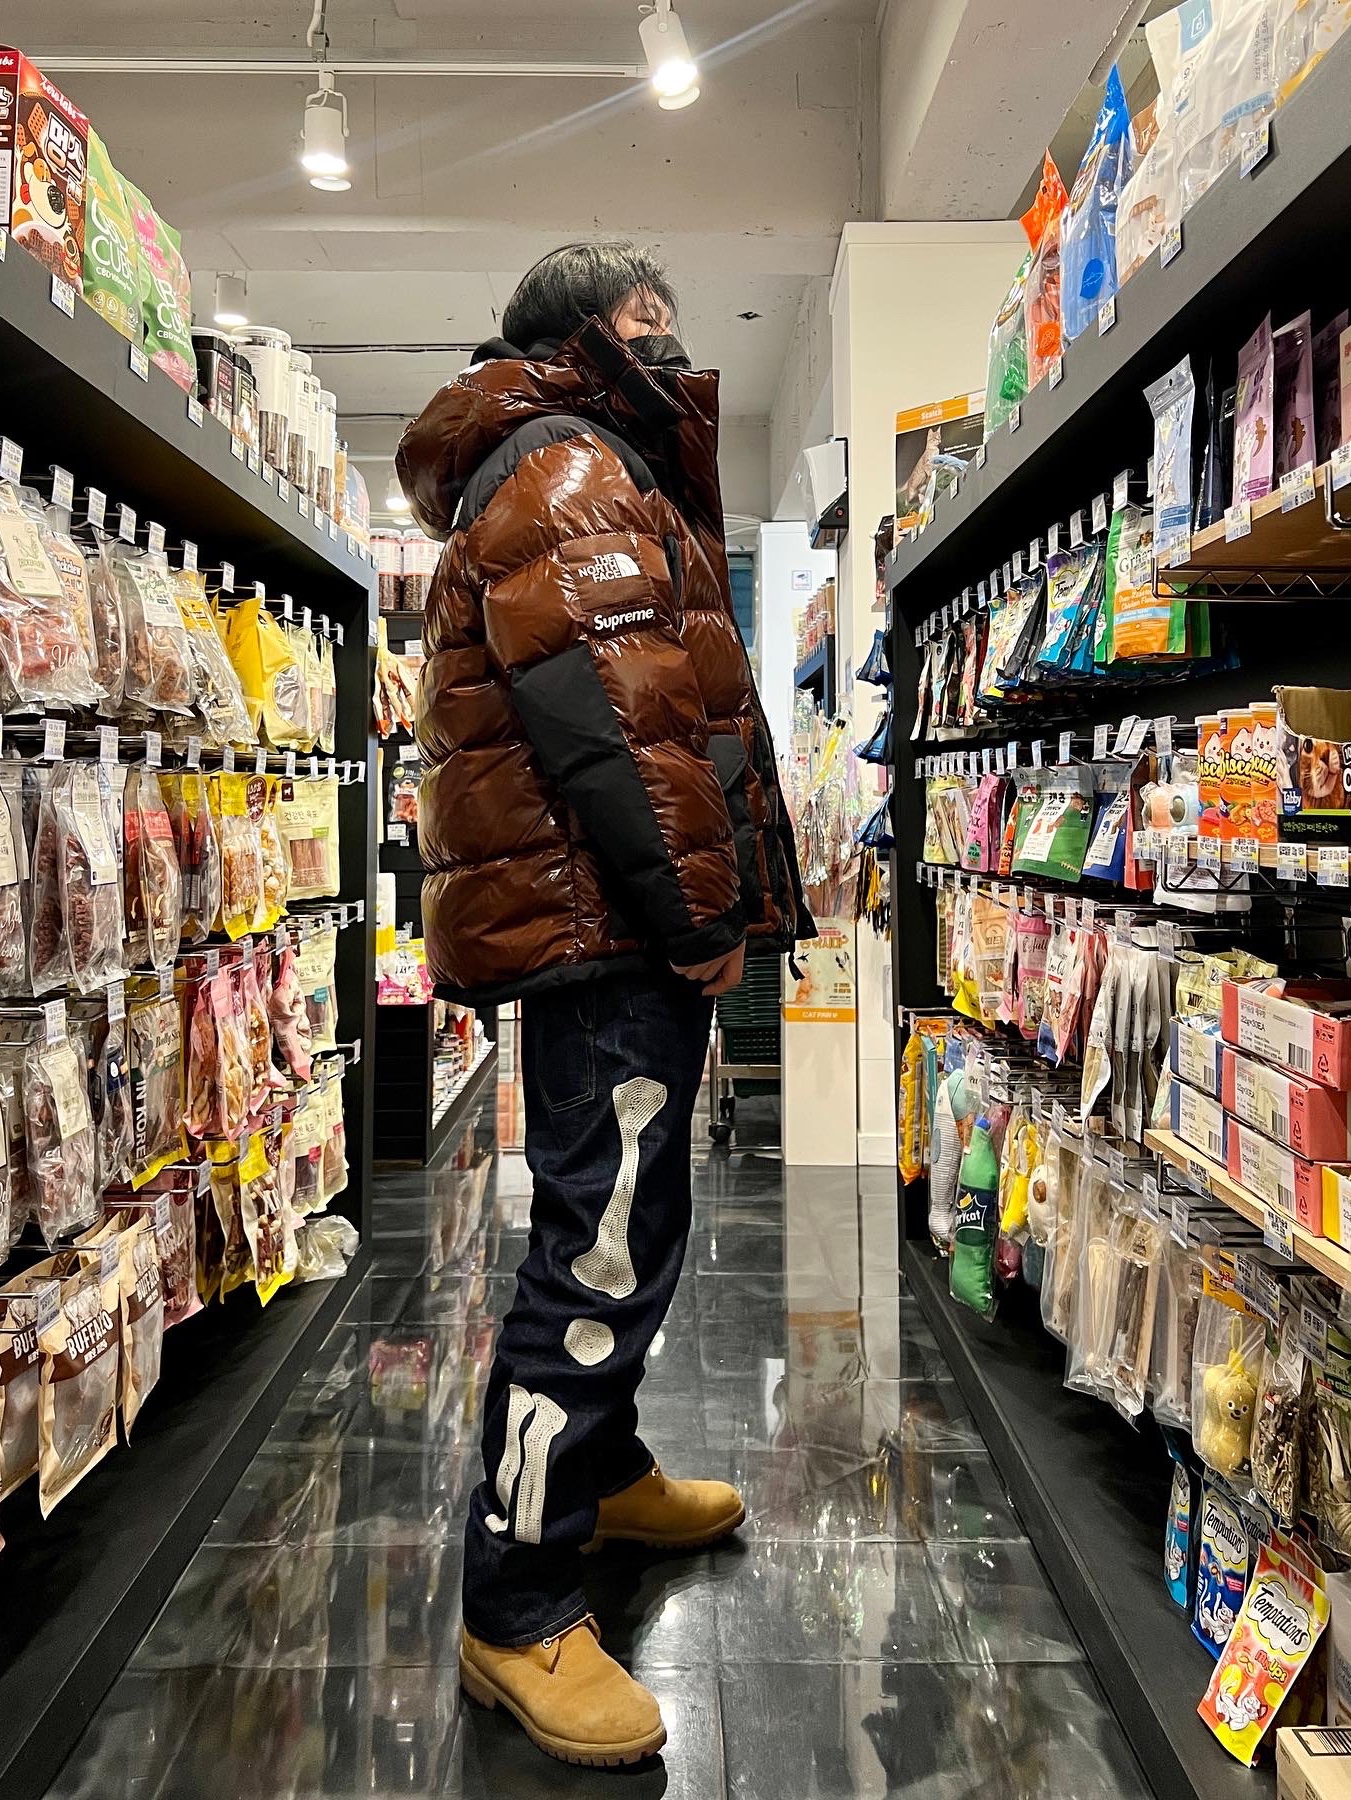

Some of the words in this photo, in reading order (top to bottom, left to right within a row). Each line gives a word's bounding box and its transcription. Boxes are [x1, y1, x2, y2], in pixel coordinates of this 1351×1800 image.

[577, 561, 619, 577] NORTH
[592, 553, 614, 565] THE
[592, 570, 621, 584] FACE
[593, 608, 654, 631] Supreme
[1283, 790, 1301, 808] Tabby
[136, 1263, 160, 1302] BUFFALO
[66, 1310, 114, 1360] BUFFALO
[1203, 1502, 1245, 1554] Temptations
[1251, 1586, 1310, 1647] Temptations
